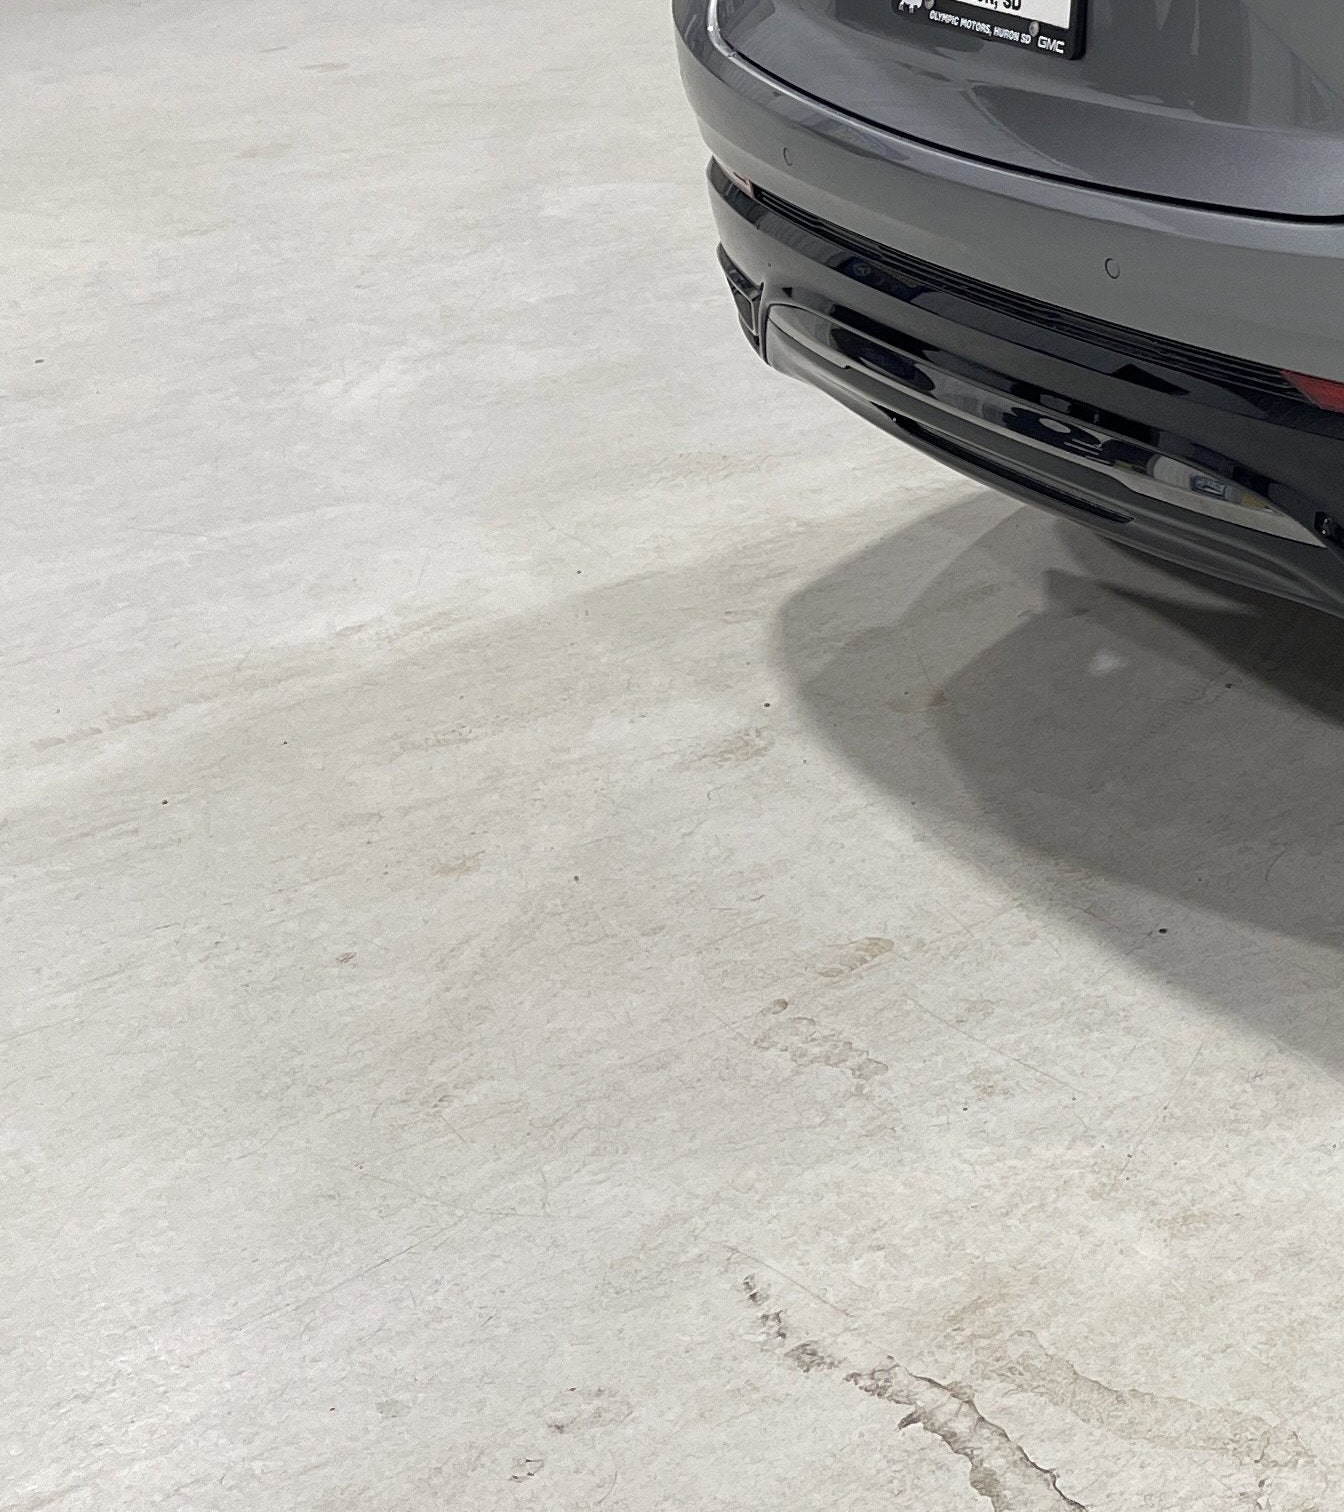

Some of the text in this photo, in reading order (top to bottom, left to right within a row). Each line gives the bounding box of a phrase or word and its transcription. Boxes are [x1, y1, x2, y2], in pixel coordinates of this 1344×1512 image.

[929, 10, 1032, 45] OLYMPIC MOTORS, HURON SD
[1037, 35, 1065, 54] GMC
